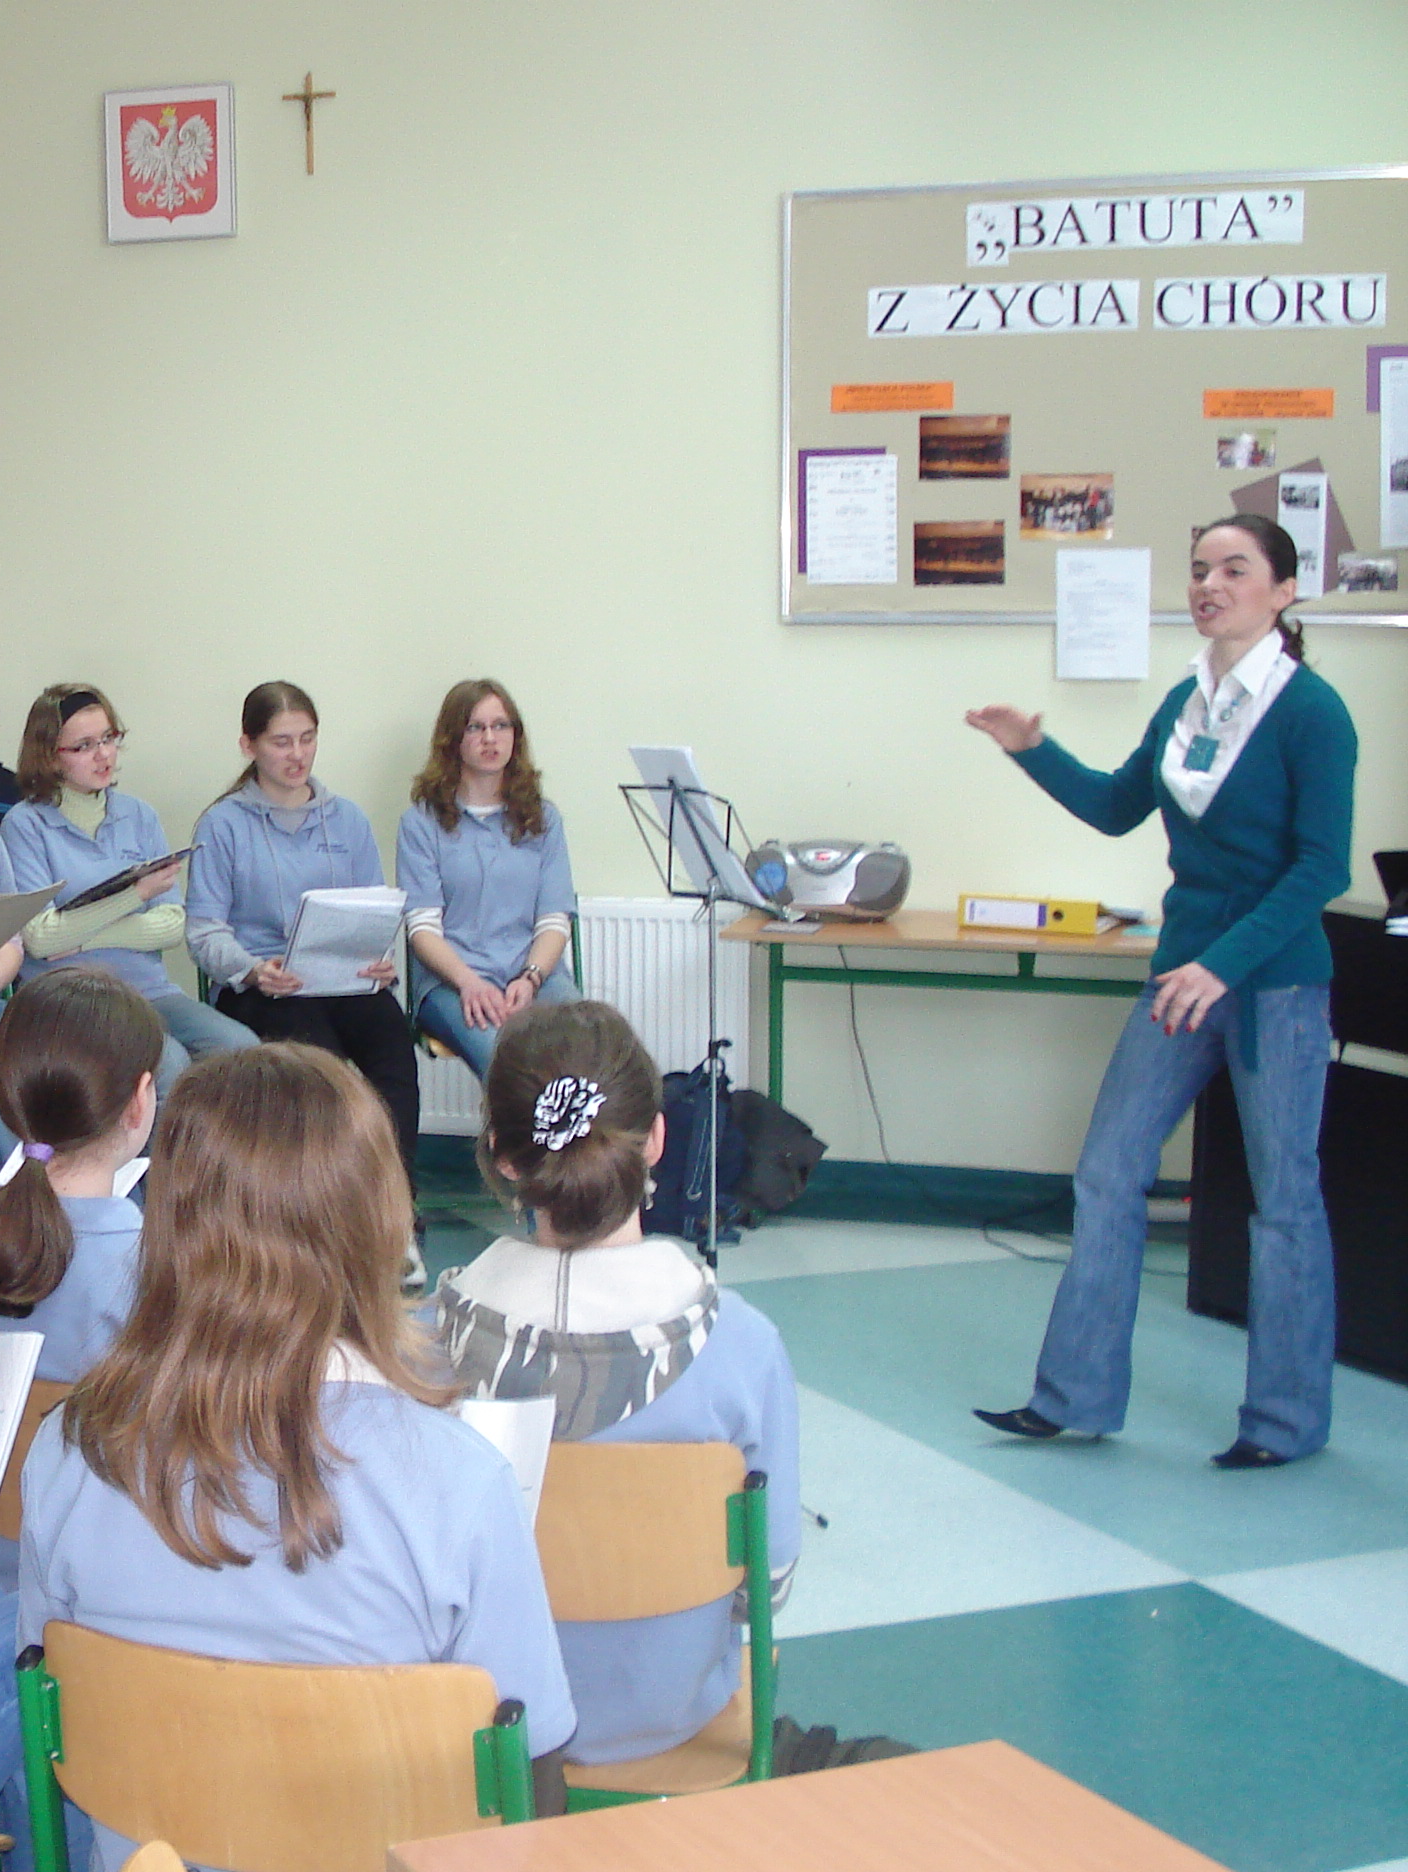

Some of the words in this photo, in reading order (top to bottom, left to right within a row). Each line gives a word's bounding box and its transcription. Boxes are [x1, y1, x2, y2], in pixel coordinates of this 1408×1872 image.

[874, 290, 909, 334] Z
[945, 282, 1130, 332] ŻYCIA
[1156, 276, 1380, 327] CHÓRU
